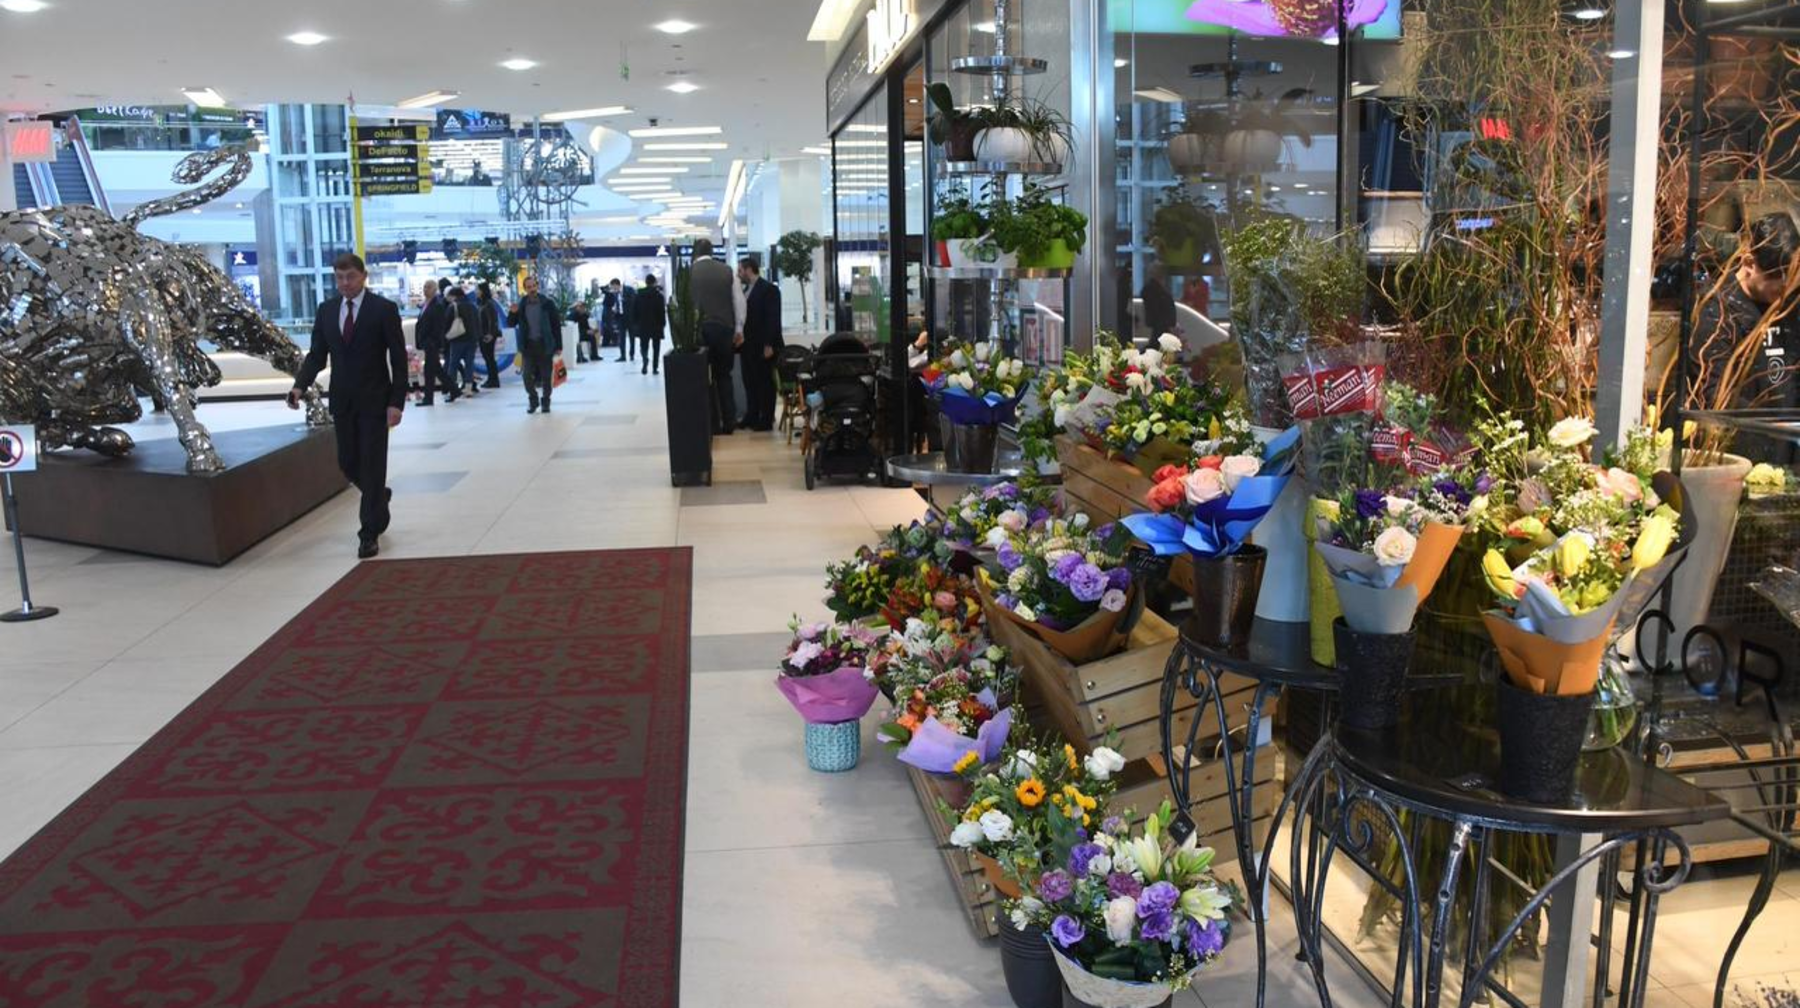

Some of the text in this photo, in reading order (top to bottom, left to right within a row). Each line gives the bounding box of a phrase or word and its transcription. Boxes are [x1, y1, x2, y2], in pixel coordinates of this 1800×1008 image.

[368, 146, 408, 156] DeFacto
[369, 165, 411, 174] Terranova
[1618, 608, 1785, 724] COR
